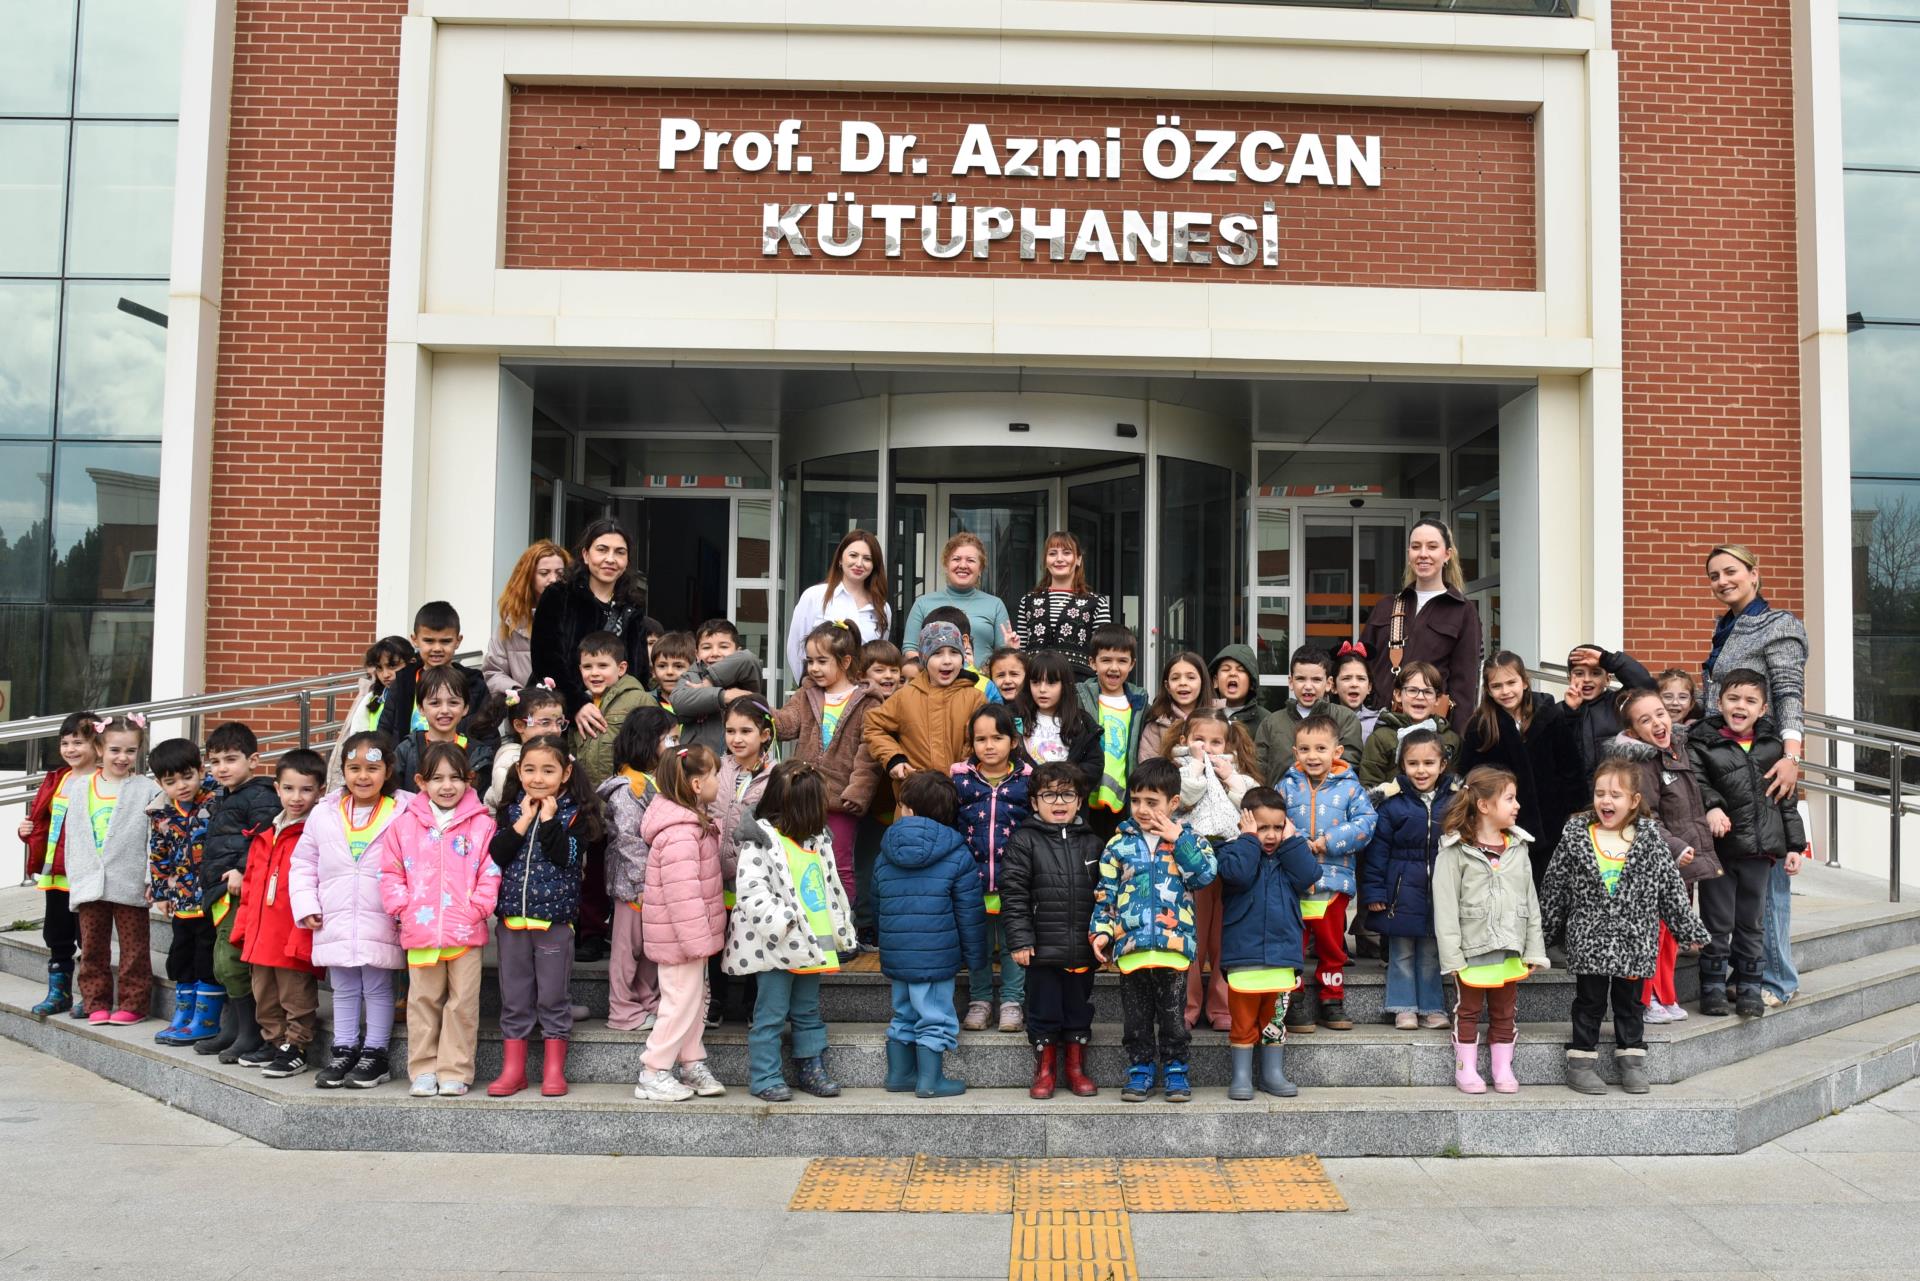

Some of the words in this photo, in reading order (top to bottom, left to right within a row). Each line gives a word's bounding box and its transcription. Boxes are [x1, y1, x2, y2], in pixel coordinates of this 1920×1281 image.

[659, 118, 813, 172] Prof.
[840, 120, 928, 175] Dr.
[951, 123, 1121, 179] Azmi
[1142, 115, 1382, 187] ÖZCAN
[762, 191, 1280, 267] KÜTÜPHANESİ
